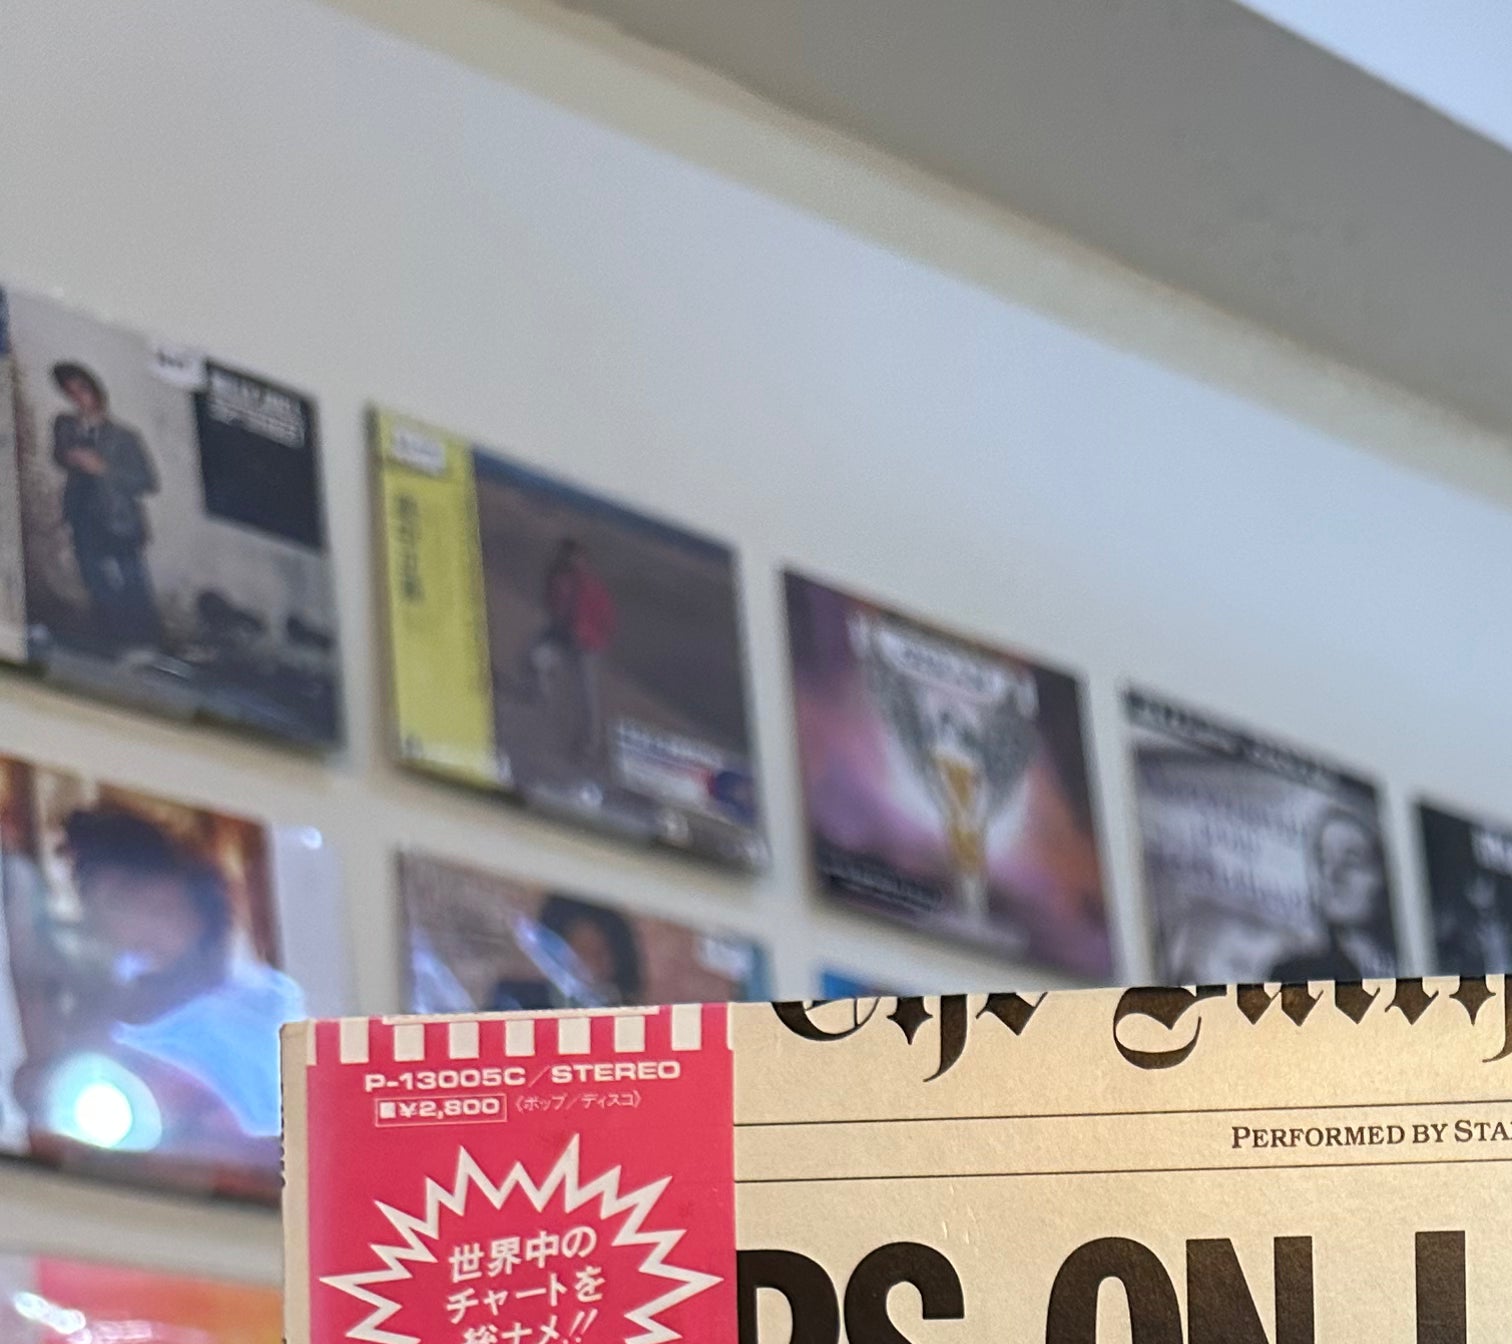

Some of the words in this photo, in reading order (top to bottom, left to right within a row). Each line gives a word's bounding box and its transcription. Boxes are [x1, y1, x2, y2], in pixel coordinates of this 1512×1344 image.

[1231, 1126, 1405, 1150] PERFORMED
[1412, 1123, 1448, 1144] BY
[448, 1225, 598, 1284] 世界中の
[446, 1265, 606, 1325] チャートを
